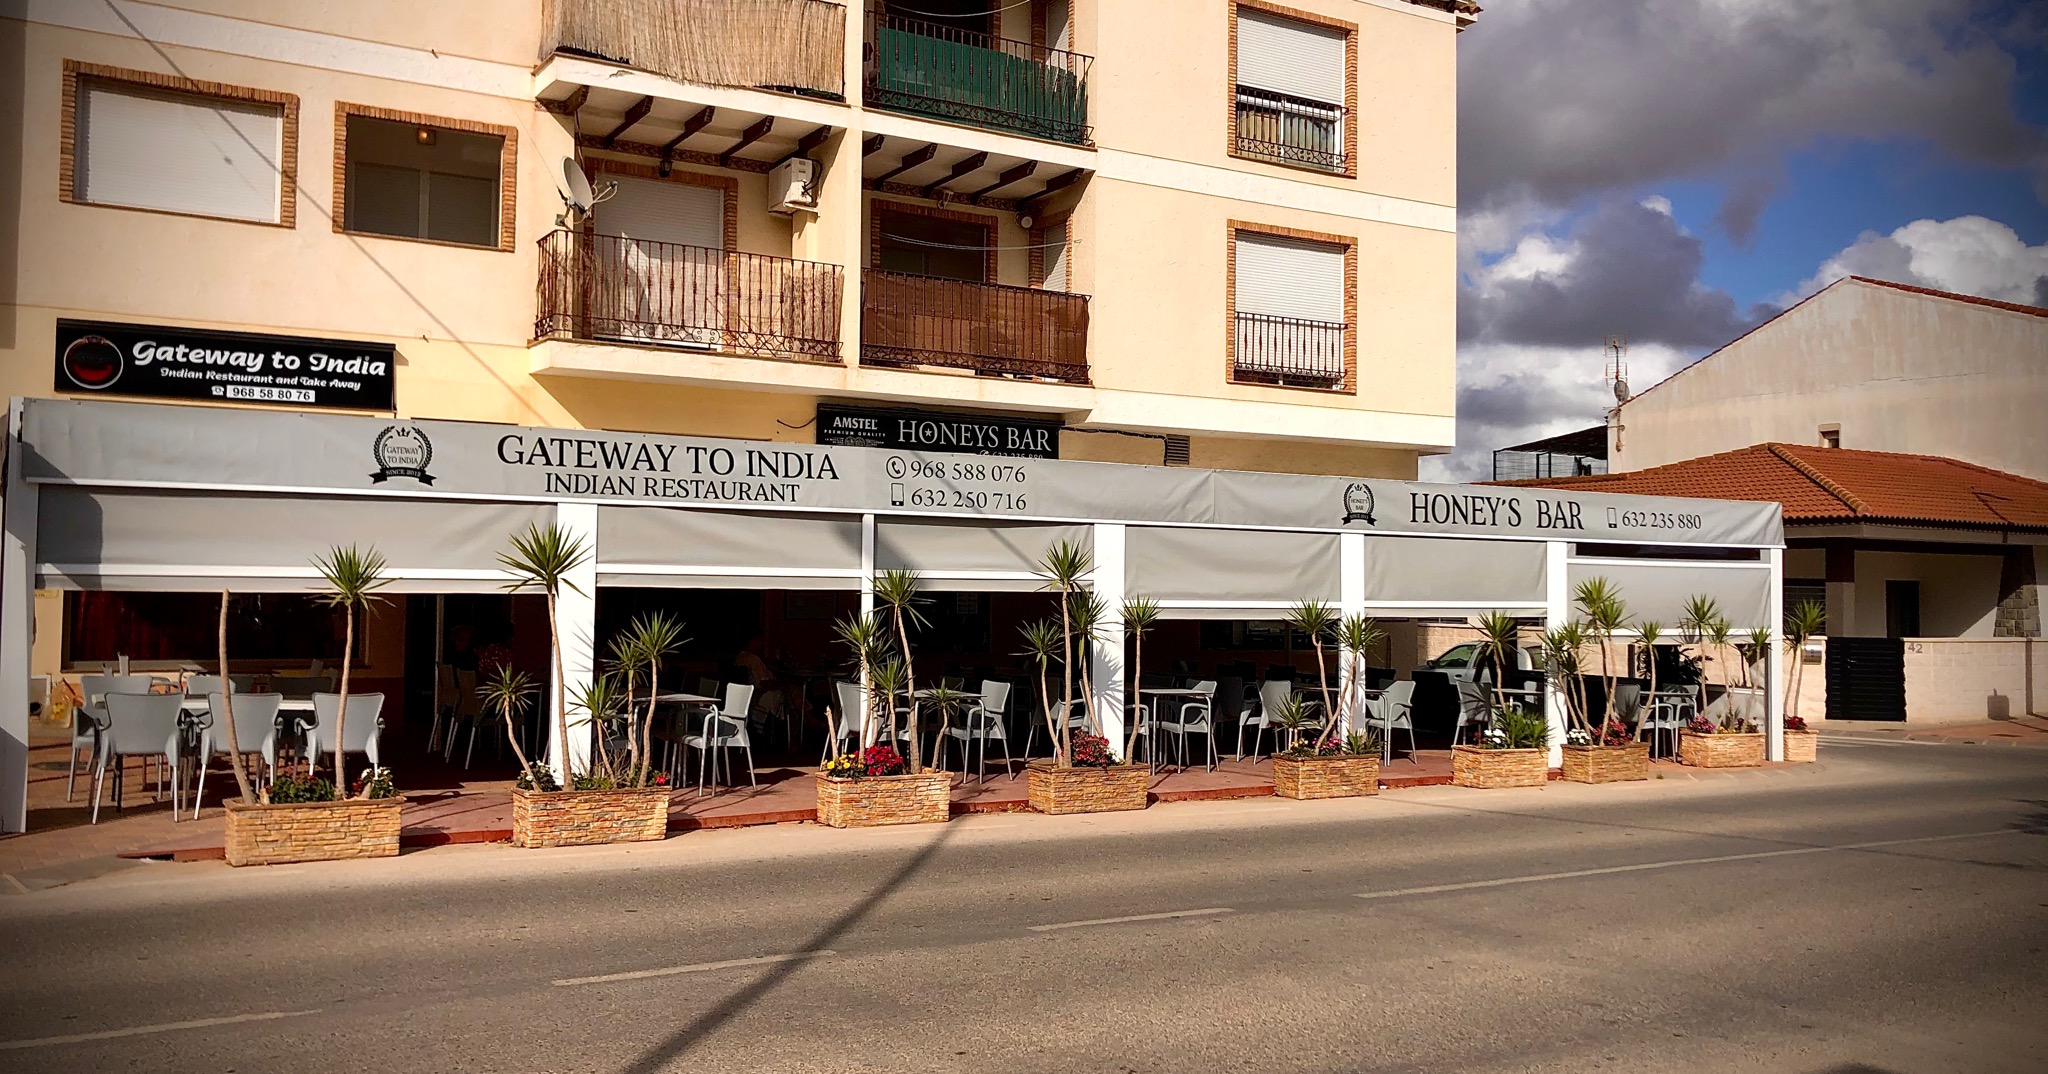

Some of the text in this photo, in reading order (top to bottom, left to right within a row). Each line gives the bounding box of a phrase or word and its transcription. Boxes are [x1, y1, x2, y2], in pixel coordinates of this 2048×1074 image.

[132, 340, 265, 372] Gateway
[271, 351, 301, 370] to
[309, 352, 386, 376] India
[160, 367, 361, 391] Indian Restaurant and Take Away
[232, 387, 311, 400] 968 58 80 76
[833, 416, 878, 430] AMSTEL
[897, 419, 1052, 451] HONEYS BAR
[387, 446, 419, 455] GATEWAY
[387, 456, 419, 465] TO INDIA
[497, 434, 840, 480] GATEWAY TO INDIA
[910, 460, 1026, 483] 968 588 076
[545, 472, 800, 502] INDIAN RESTAURANT
[911, 487, 1027, 510] 632 250 716
[1409, 493, 1585, 530] HONEY'S BAR
[1622, 511, 1702, 529] 632 235 880
[1907, 643, 1923, 654] 42
